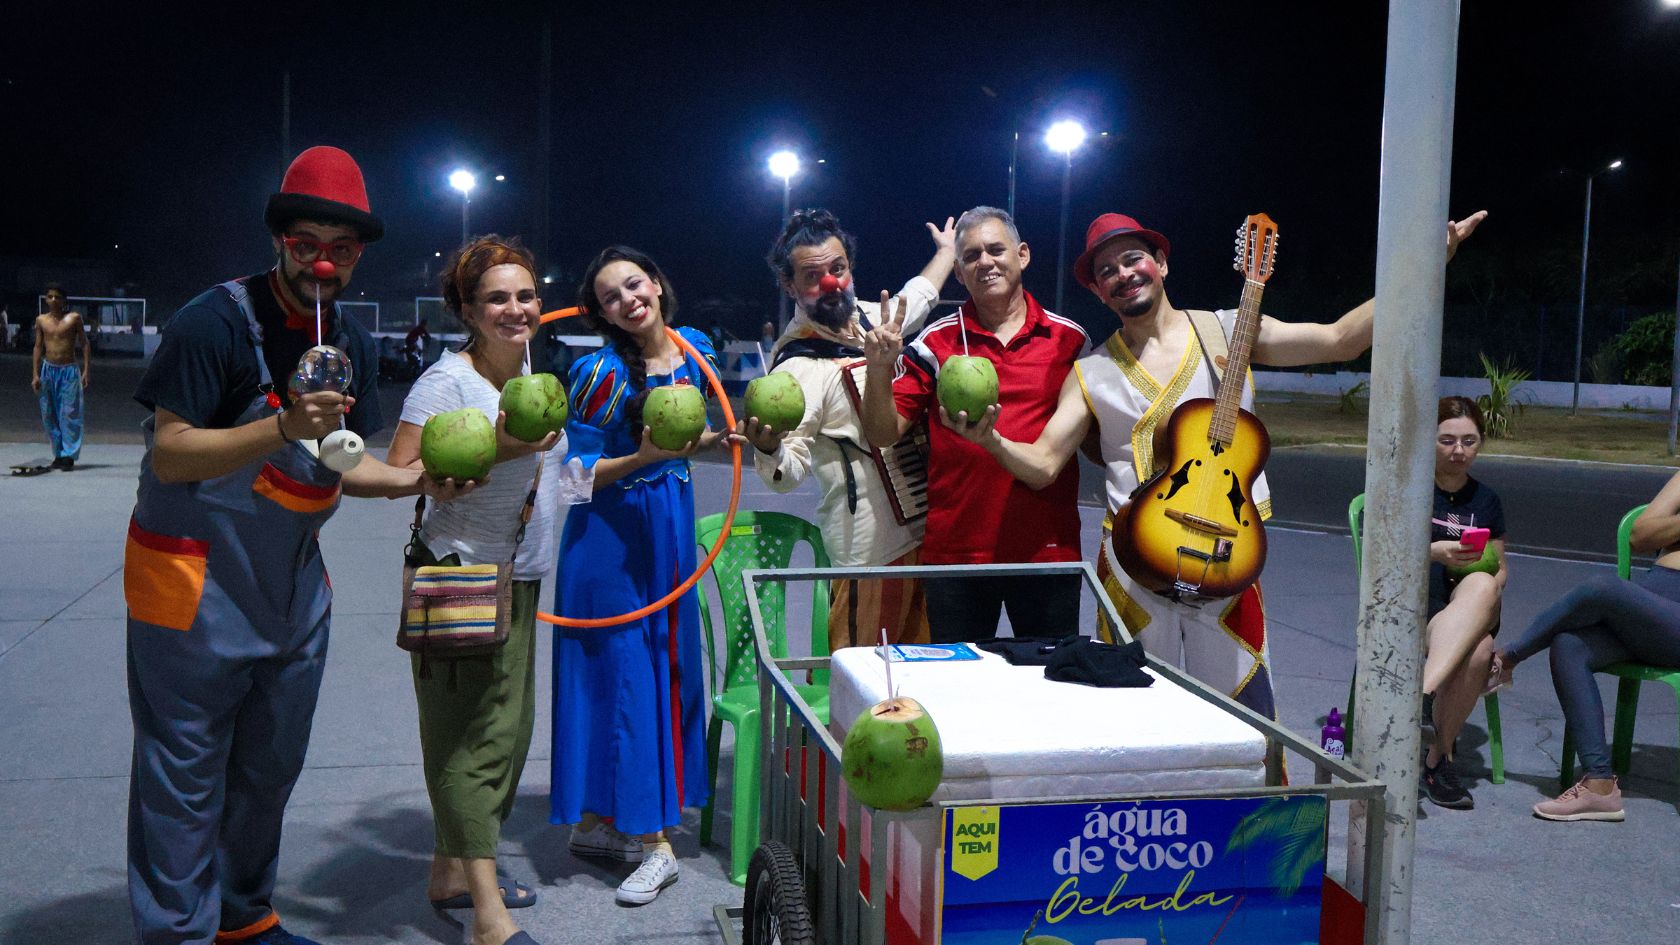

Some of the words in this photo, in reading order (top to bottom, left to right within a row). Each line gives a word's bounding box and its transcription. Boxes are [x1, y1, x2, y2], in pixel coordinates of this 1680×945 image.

[956, 823, 996, 838] AQUI
[959, 841, 992, 854] TEM
[1083, 804, 1187, 854] água
[1052, 835, 1105, 875] de
[1115, 841, 1214, 872] coco
[1045, 869, 1234, 924] Gelada
